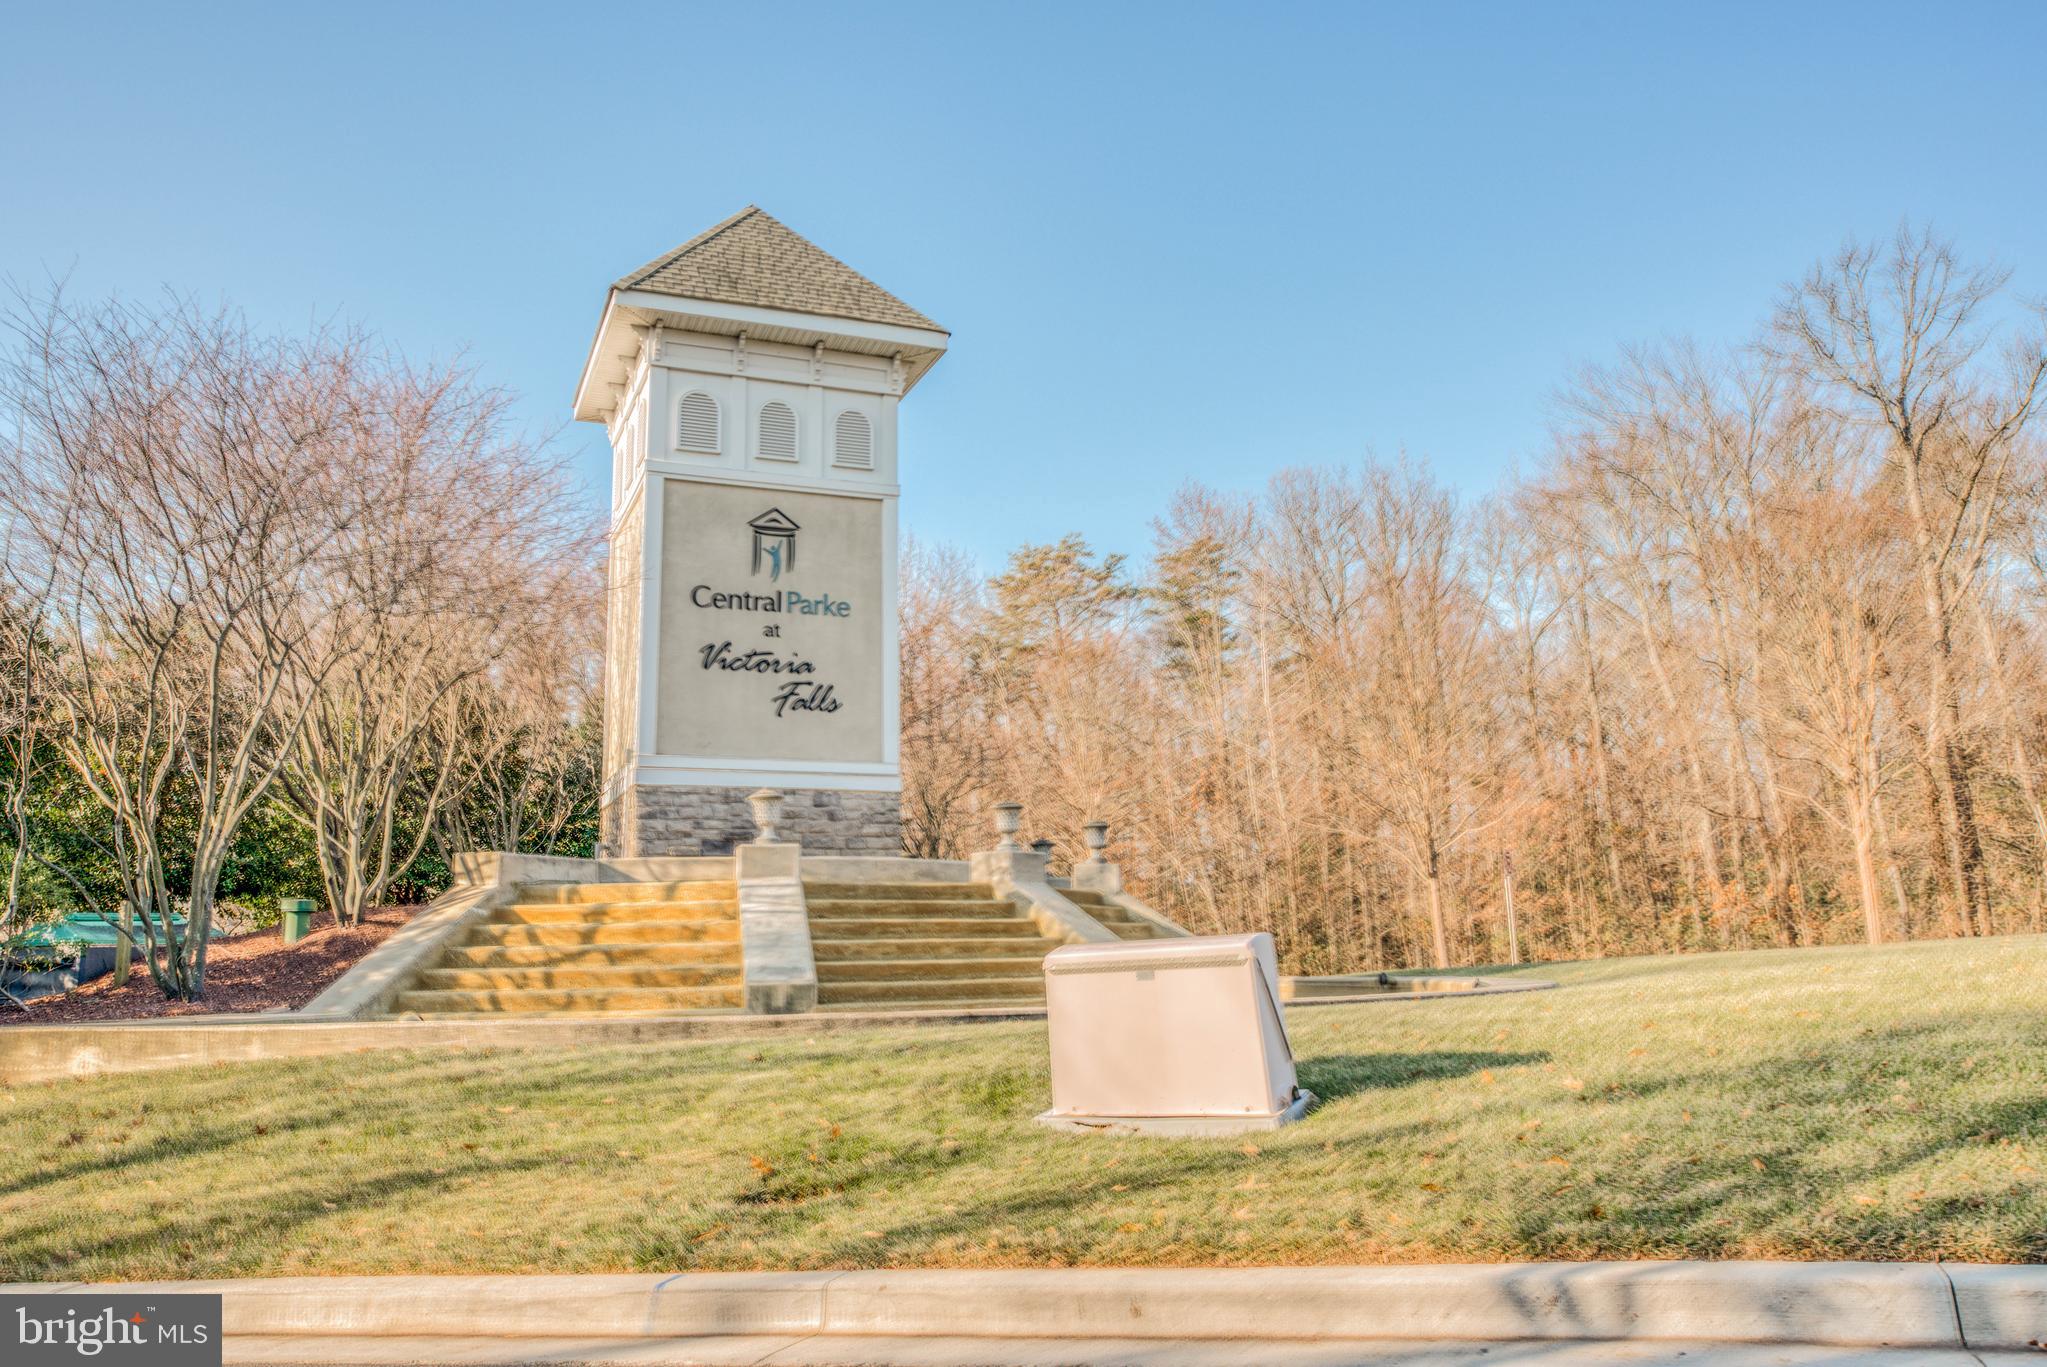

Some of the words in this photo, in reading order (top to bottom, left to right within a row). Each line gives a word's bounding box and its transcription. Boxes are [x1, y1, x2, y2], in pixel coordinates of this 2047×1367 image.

[690, 584, 782, 613] Central
[786, 591, 851, 617] Parke
[762, 624, 781, 638] at
[699, 640, 816, 674] Victoria
[771, 681, 843, 718] Falls
